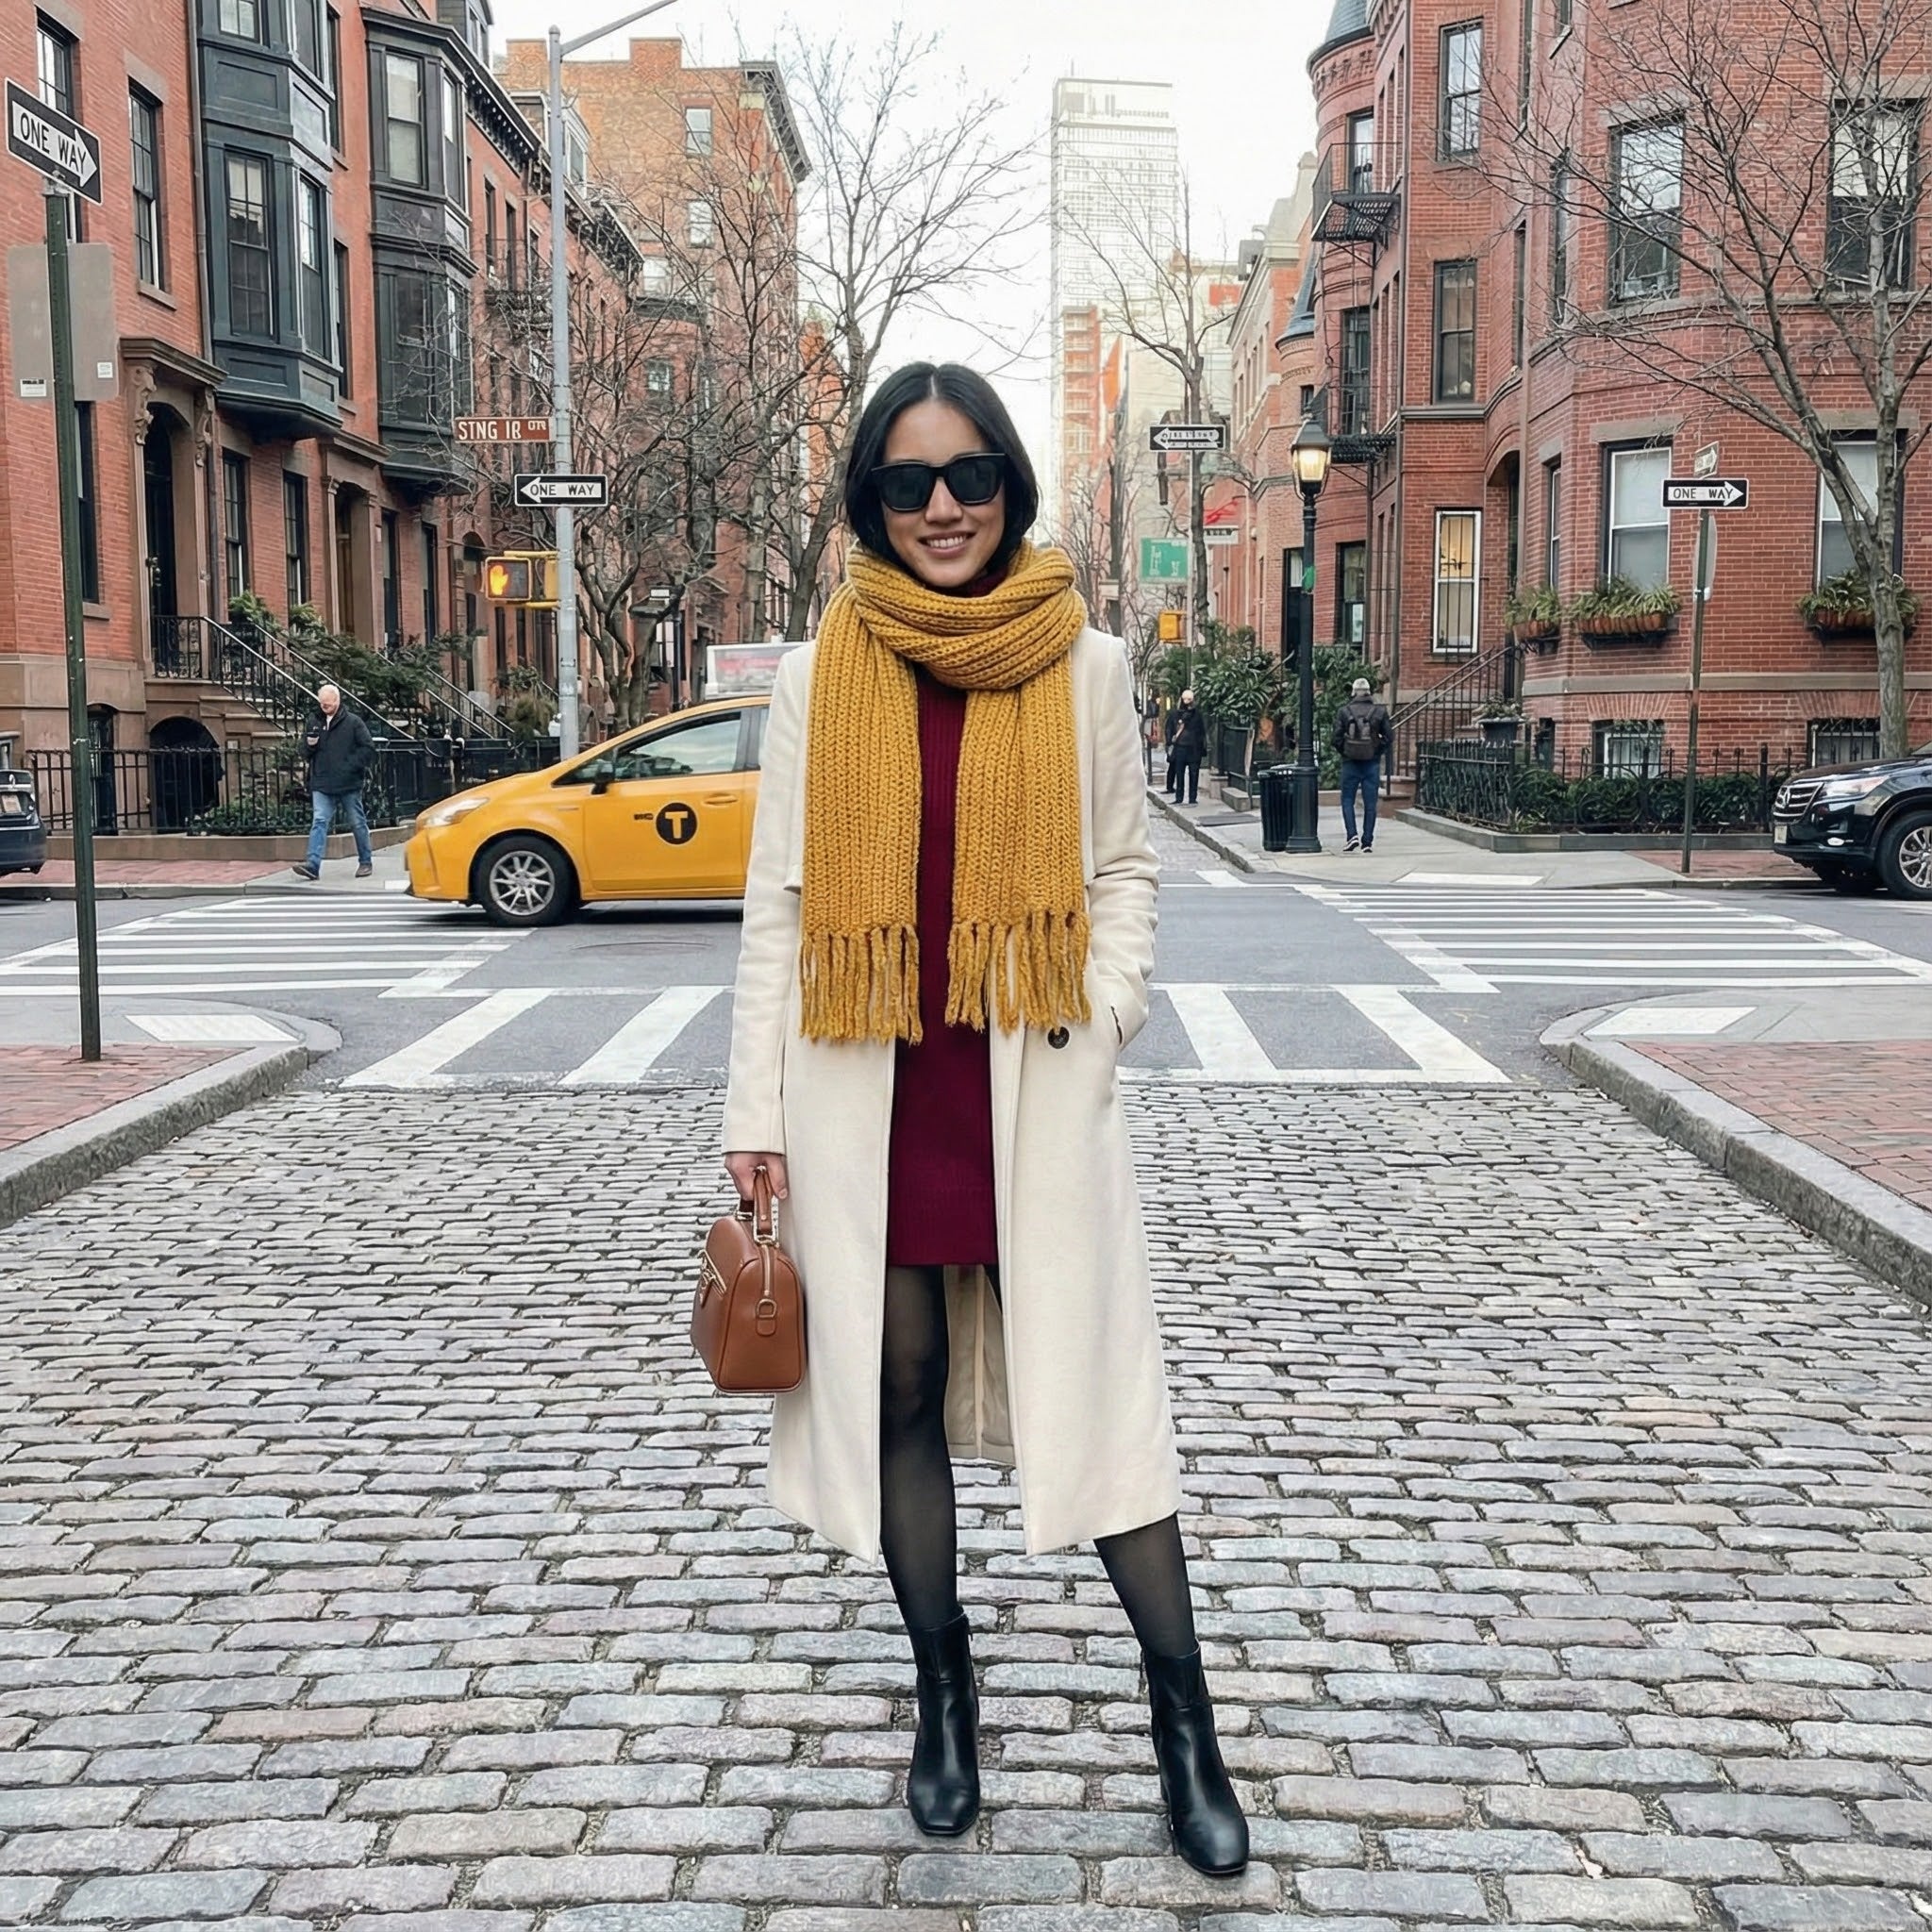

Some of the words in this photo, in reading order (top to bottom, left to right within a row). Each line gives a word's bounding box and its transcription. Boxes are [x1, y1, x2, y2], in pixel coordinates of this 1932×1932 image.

[21, 112, 50, 154] ONE
[58, 135, 86, 175] WAY
[458, 421, 498, 440] STNG
[529, 484, 557, 496] ONE
[568, 484, 594, 495] WAY
[1673, 488, 1697, 499] ONE
[1708, 489, 1734, 499] WAY
[664, 811, 689, 839] T
